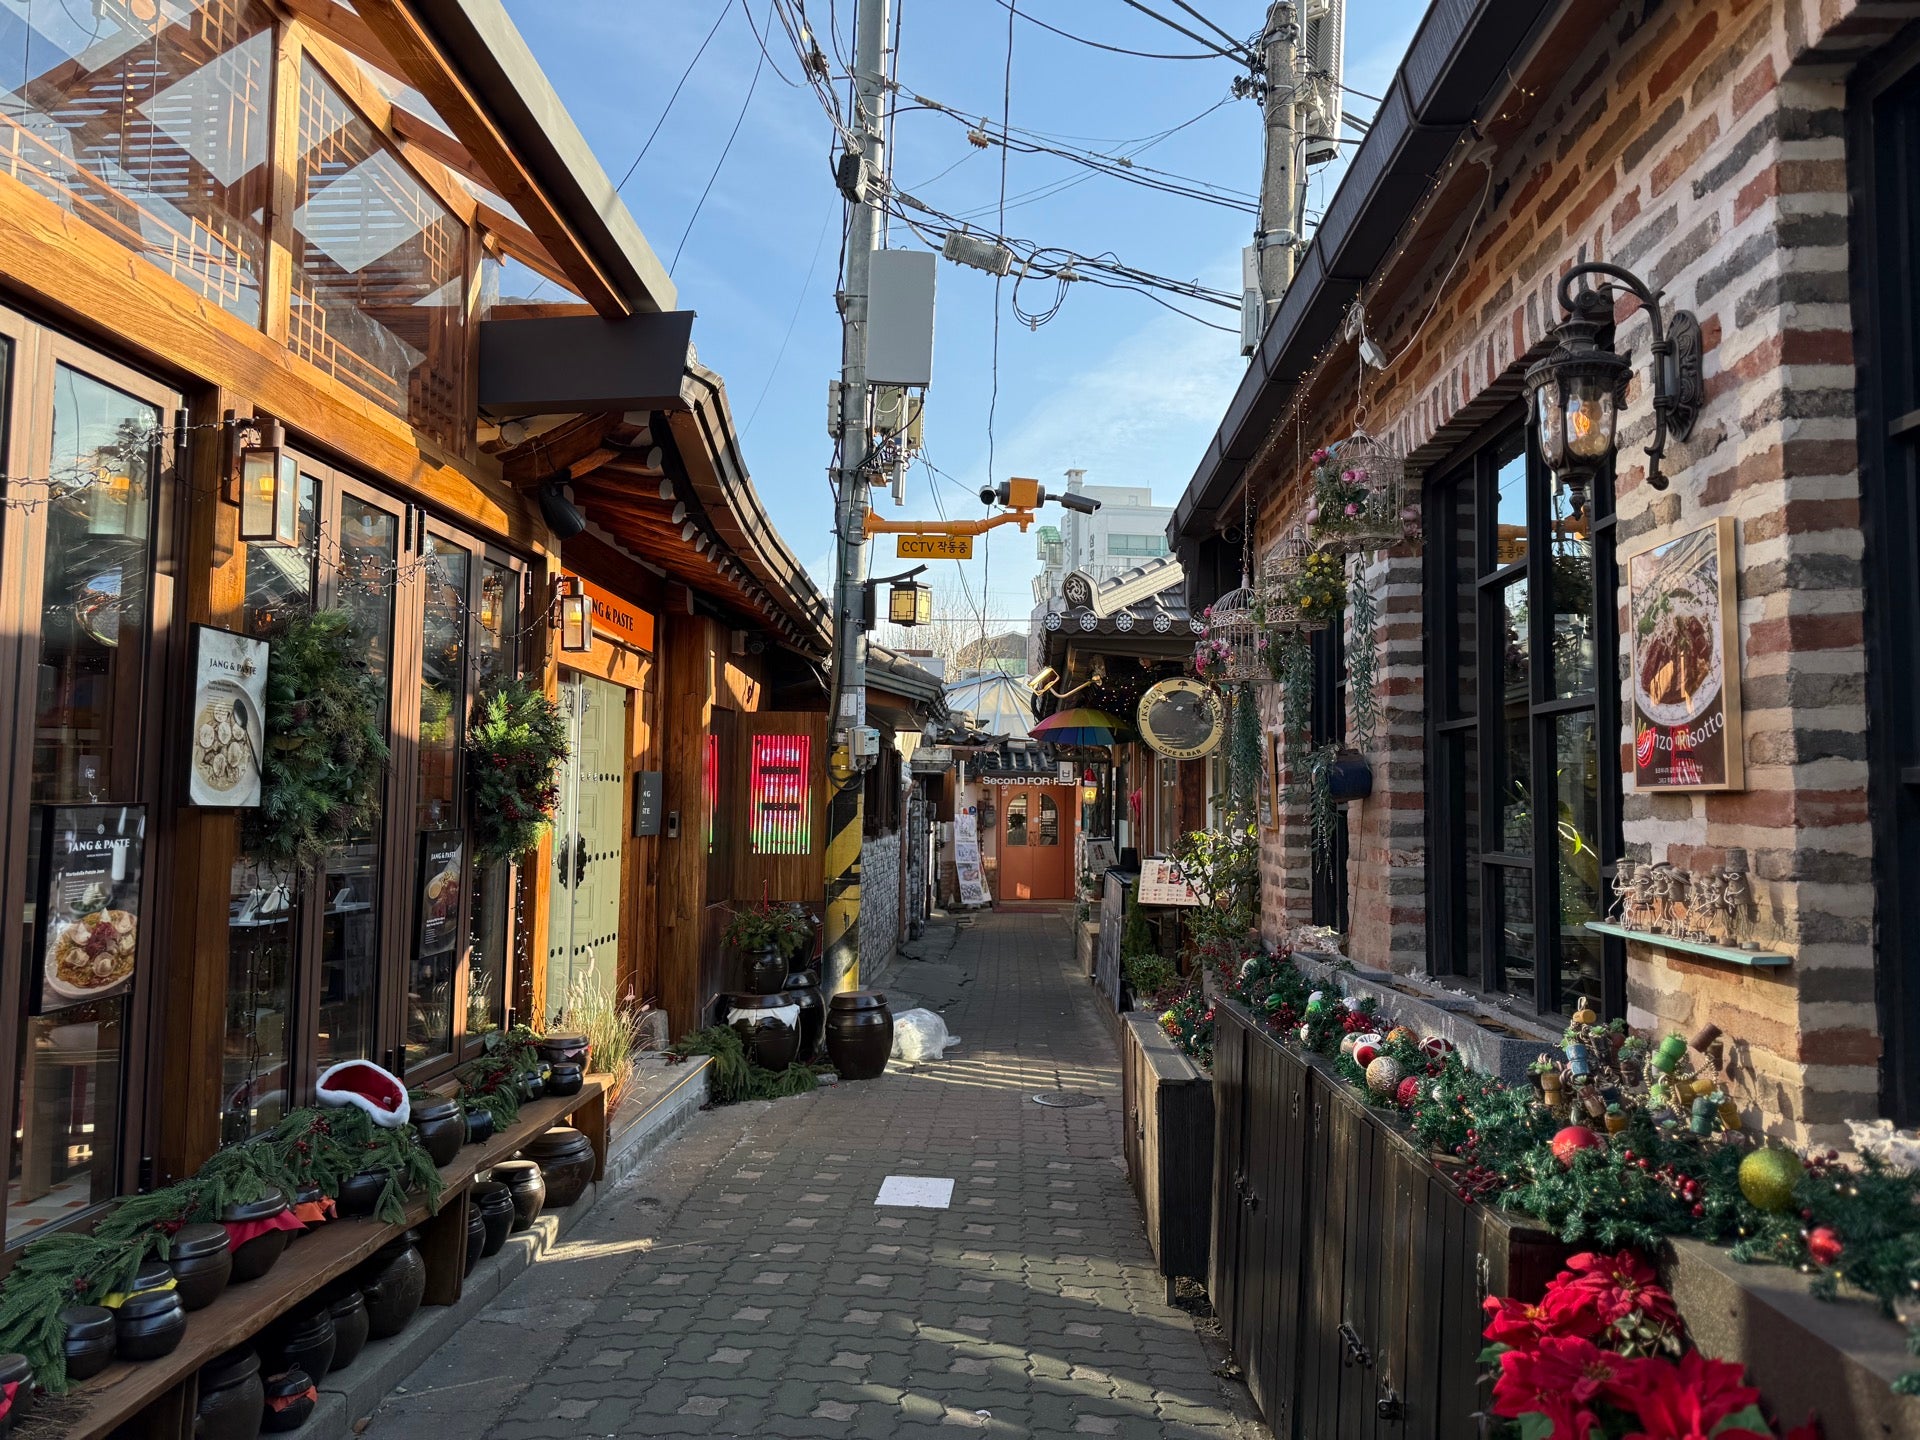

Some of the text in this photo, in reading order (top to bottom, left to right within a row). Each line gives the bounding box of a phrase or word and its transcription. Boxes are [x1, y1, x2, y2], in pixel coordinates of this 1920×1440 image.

[902, 541, 968, 553] CCTV 작동중
[605, 605, 611, 621] &
[612, 608, 633, 631] PASTE
[209, 658, 229, 670] JANG
[229, 662, 235, 671] &
[1141, 687, 1163, 722] IKSEON
[1678, 712, 1724, 750] Risotto
[1158, 745, 1177, 756] CAFE
[983, 776, 1025, 785] SeconD
[68, 838, 130, 854] JANG & PASTE
